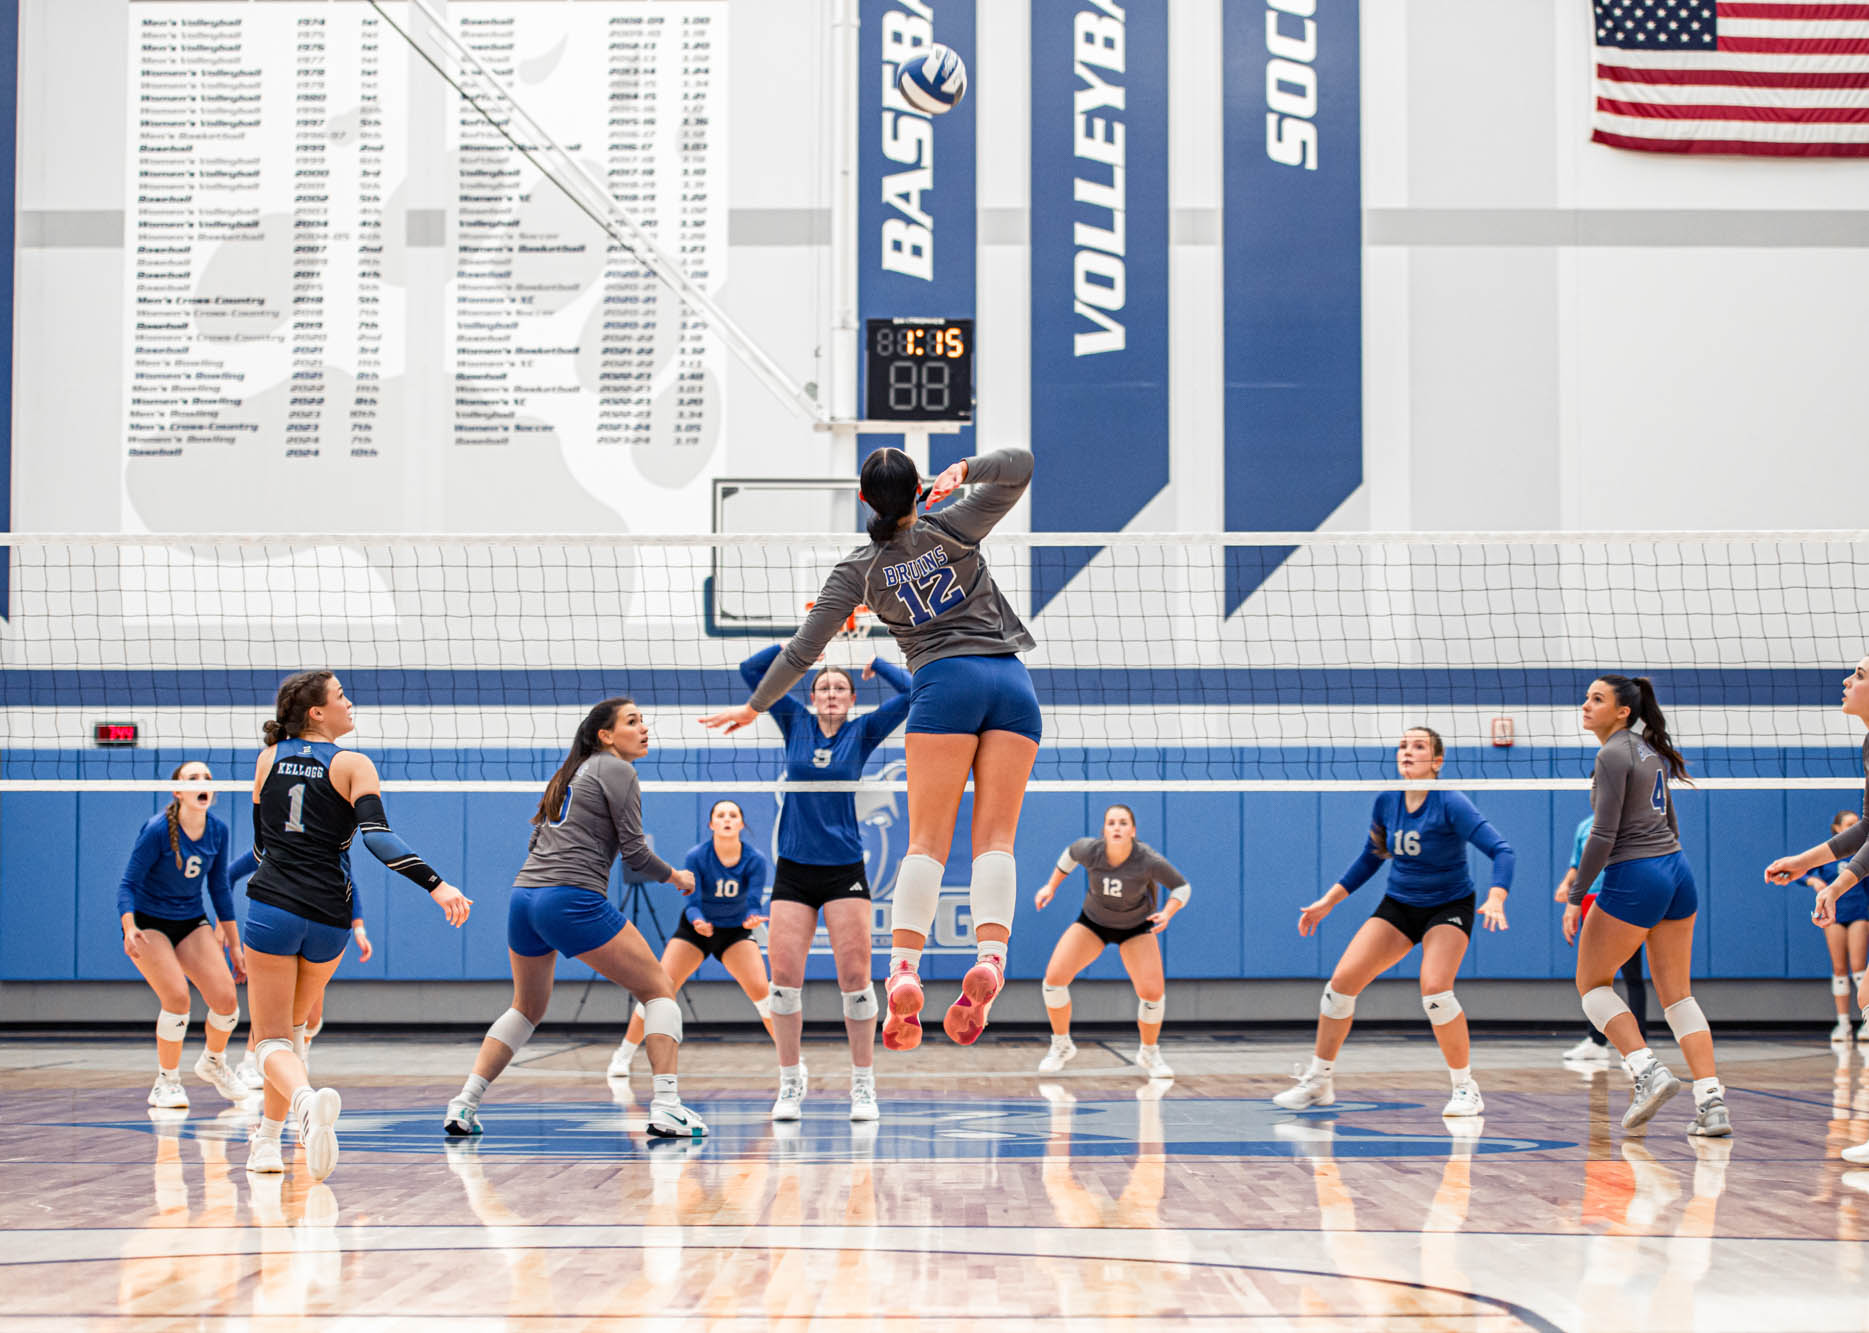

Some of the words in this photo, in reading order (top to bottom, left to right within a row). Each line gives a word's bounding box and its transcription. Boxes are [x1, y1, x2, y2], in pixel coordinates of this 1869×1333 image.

[1266, 0, 1318, 171] SOC
[1074, 0, 1126, 356] VOLLEYB
[906, 327, 964, 358] 1:15
[882, 544, 948, 587] BRUINS
[895, 565, 966, 627] 12
[277, 762, 325, 779] KELLOGG
[284, 783, 306, 833] 1
[1649, 768, 1667, 815] 4
[1393, 829, 1423, 857] 16
[184, 855, 202, 879] 6
[714, 879, 740, 899] 10
[1101, 876, 1124, 898] 12
